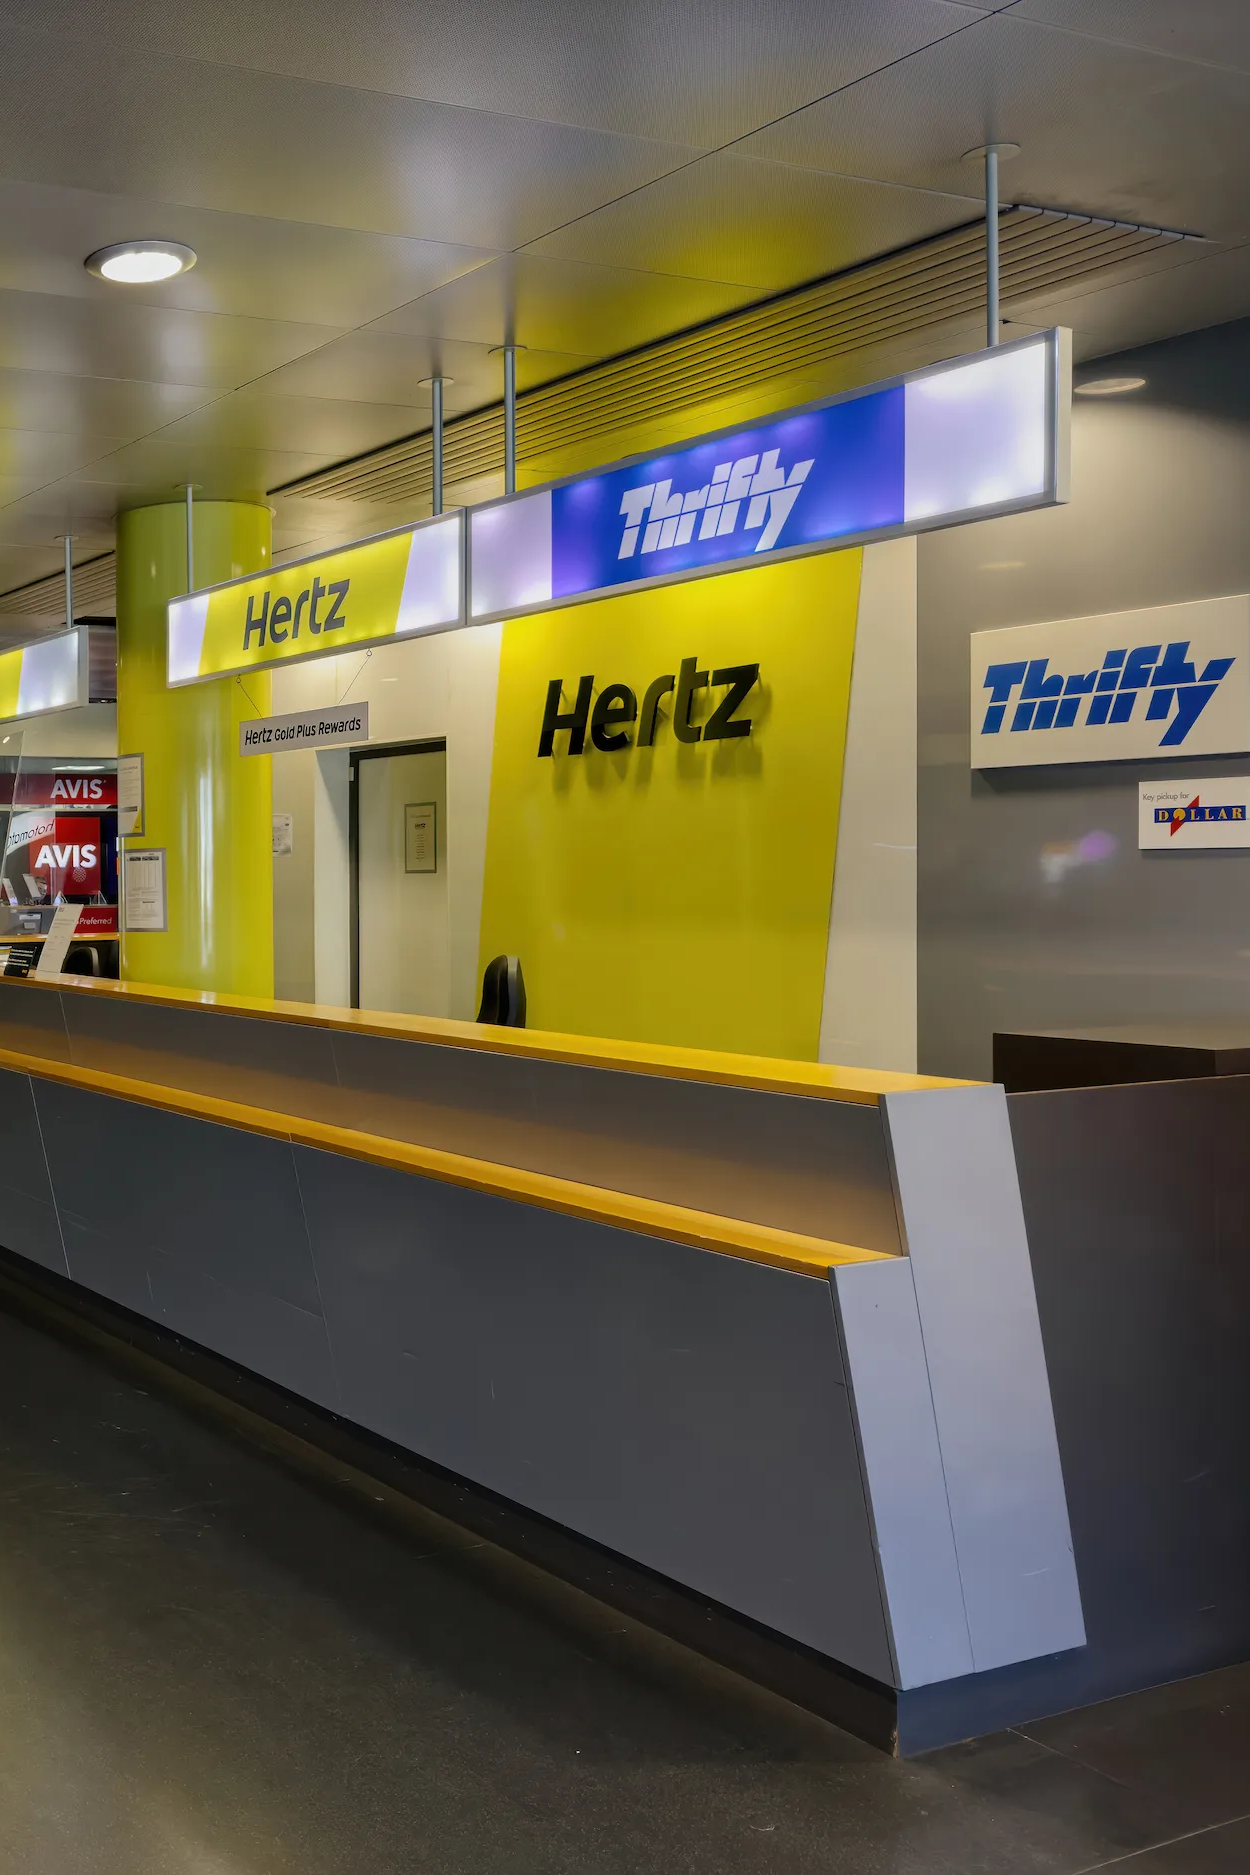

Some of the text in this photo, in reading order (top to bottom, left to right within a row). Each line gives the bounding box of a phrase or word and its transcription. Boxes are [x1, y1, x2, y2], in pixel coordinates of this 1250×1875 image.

[617, 447, 816, 560] Thrifty
[242, 576, 351, 651] Hertz
[537, 656, 761, 758] Hertz
[980, 640, 1238, 747] Thrifty
[244, 717, 361, 746] Hertz Gold Plus Rewards
[50, 779, 103, 799] AVIS
[1142, 791, 1190, 802] Key pickup for
[1158, 807, 1243, 822] DOLLAR
[34, 844, 97, 869] AVIS
[79, 916, 112, 925] Preferred
